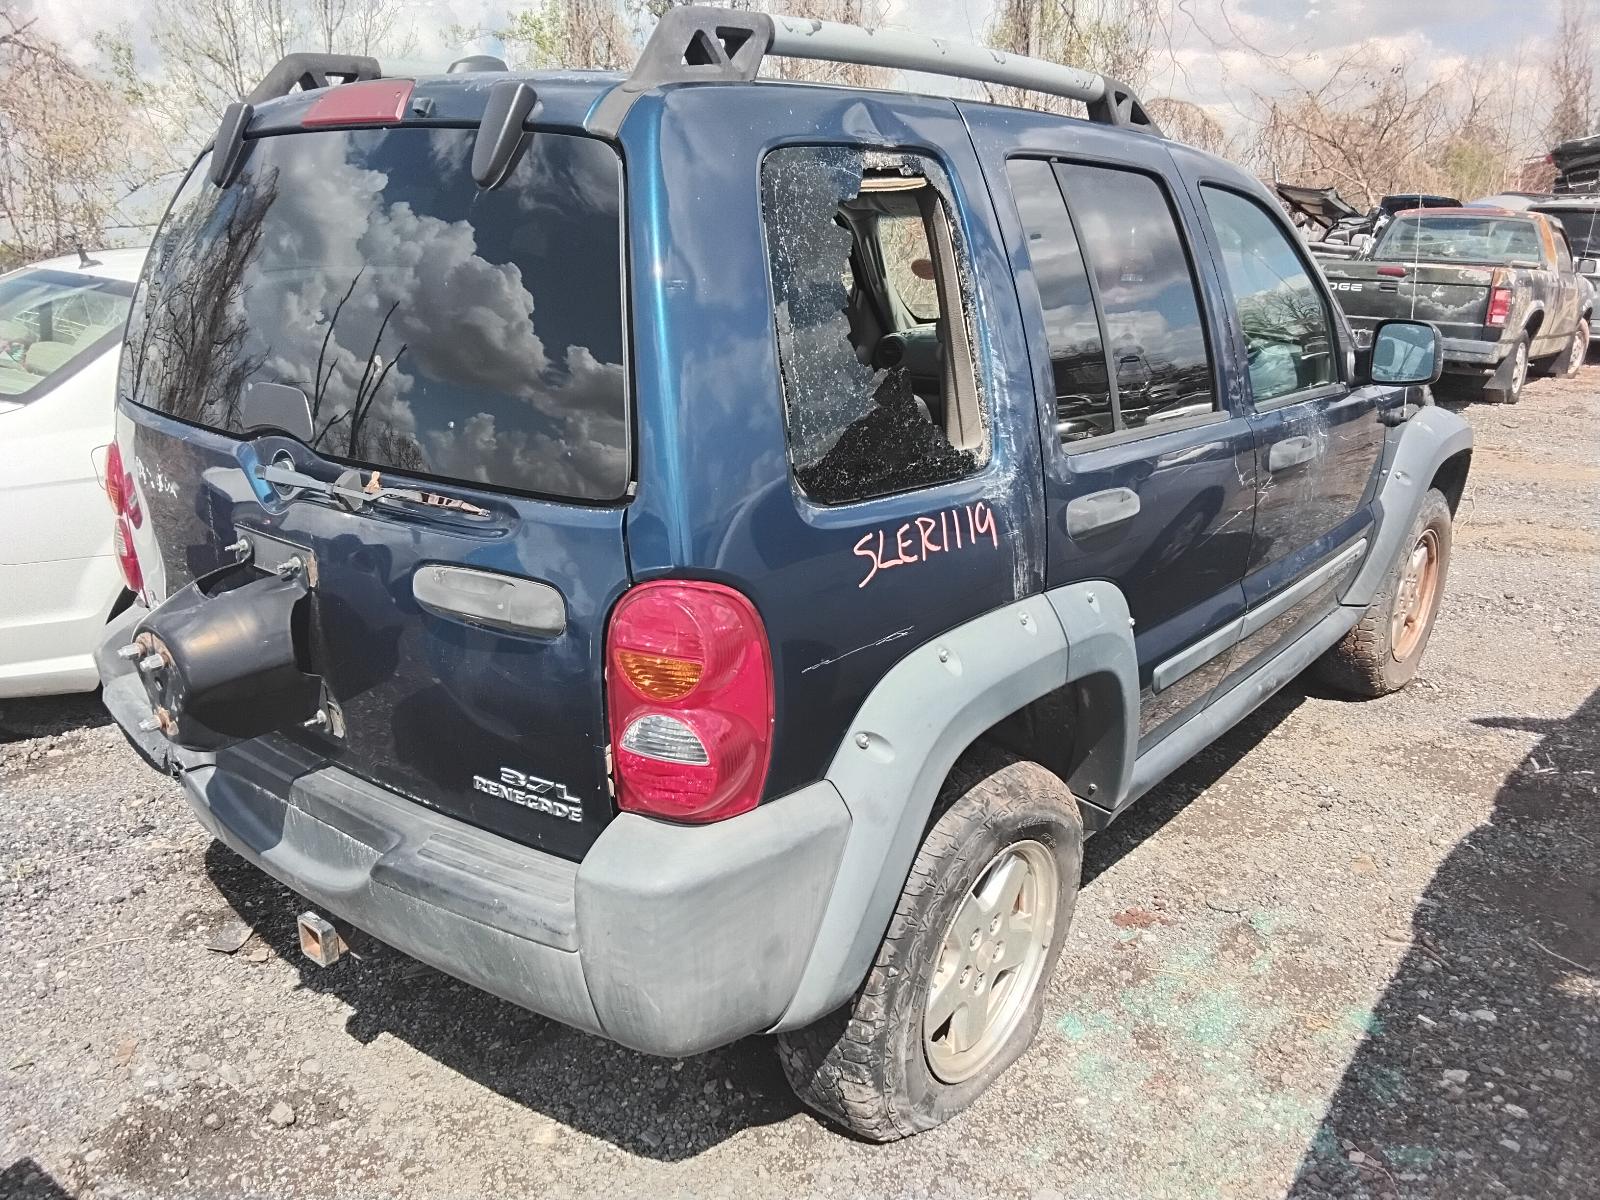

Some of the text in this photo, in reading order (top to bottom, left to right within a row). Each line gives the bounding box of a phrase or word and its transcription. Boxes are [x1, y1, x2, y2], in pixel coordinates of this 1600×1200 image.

[1328, 282, 1363, 292] DGE
[853, 501, 998, 588] SLER1119
[473, 775, 583, 822] RENEGADE
